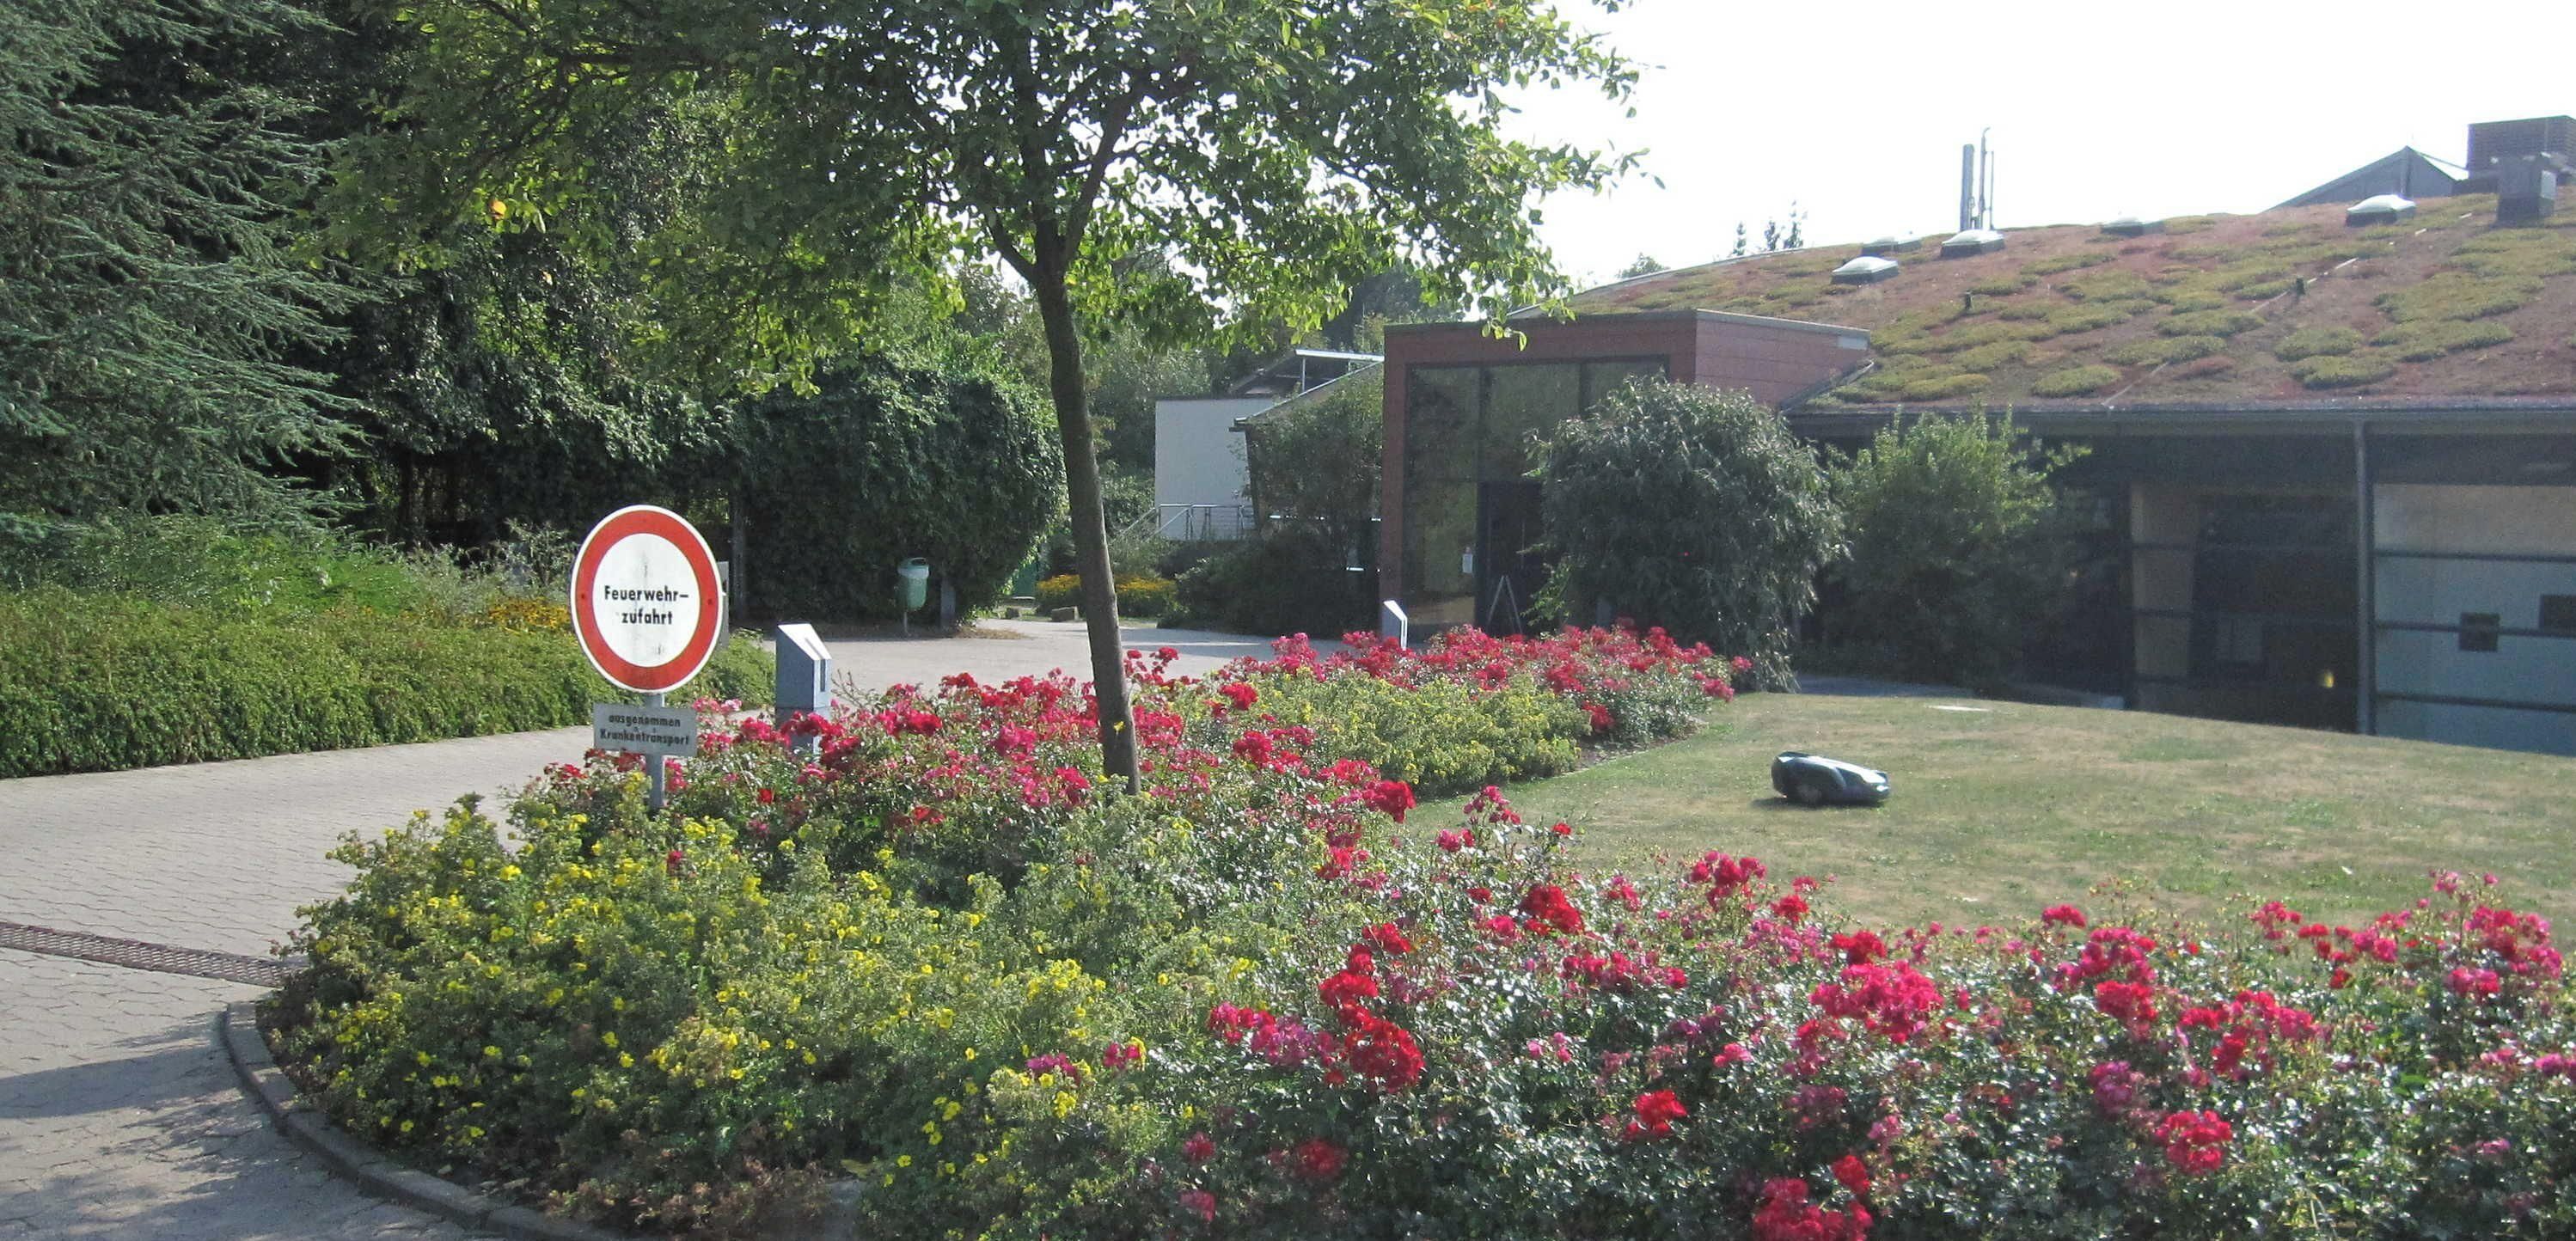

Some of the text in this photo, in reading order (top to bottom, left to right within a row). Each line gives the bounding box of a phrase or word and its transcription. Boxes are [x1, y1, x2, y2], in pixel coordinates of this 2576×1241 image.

[604, 585, 689, 602] Feuerwehr-
[621, 608, 672, 625] zufahrt
[609, 715, 681, 727] ausgenommen
[600, 729, 689, 746] Krankentransport
